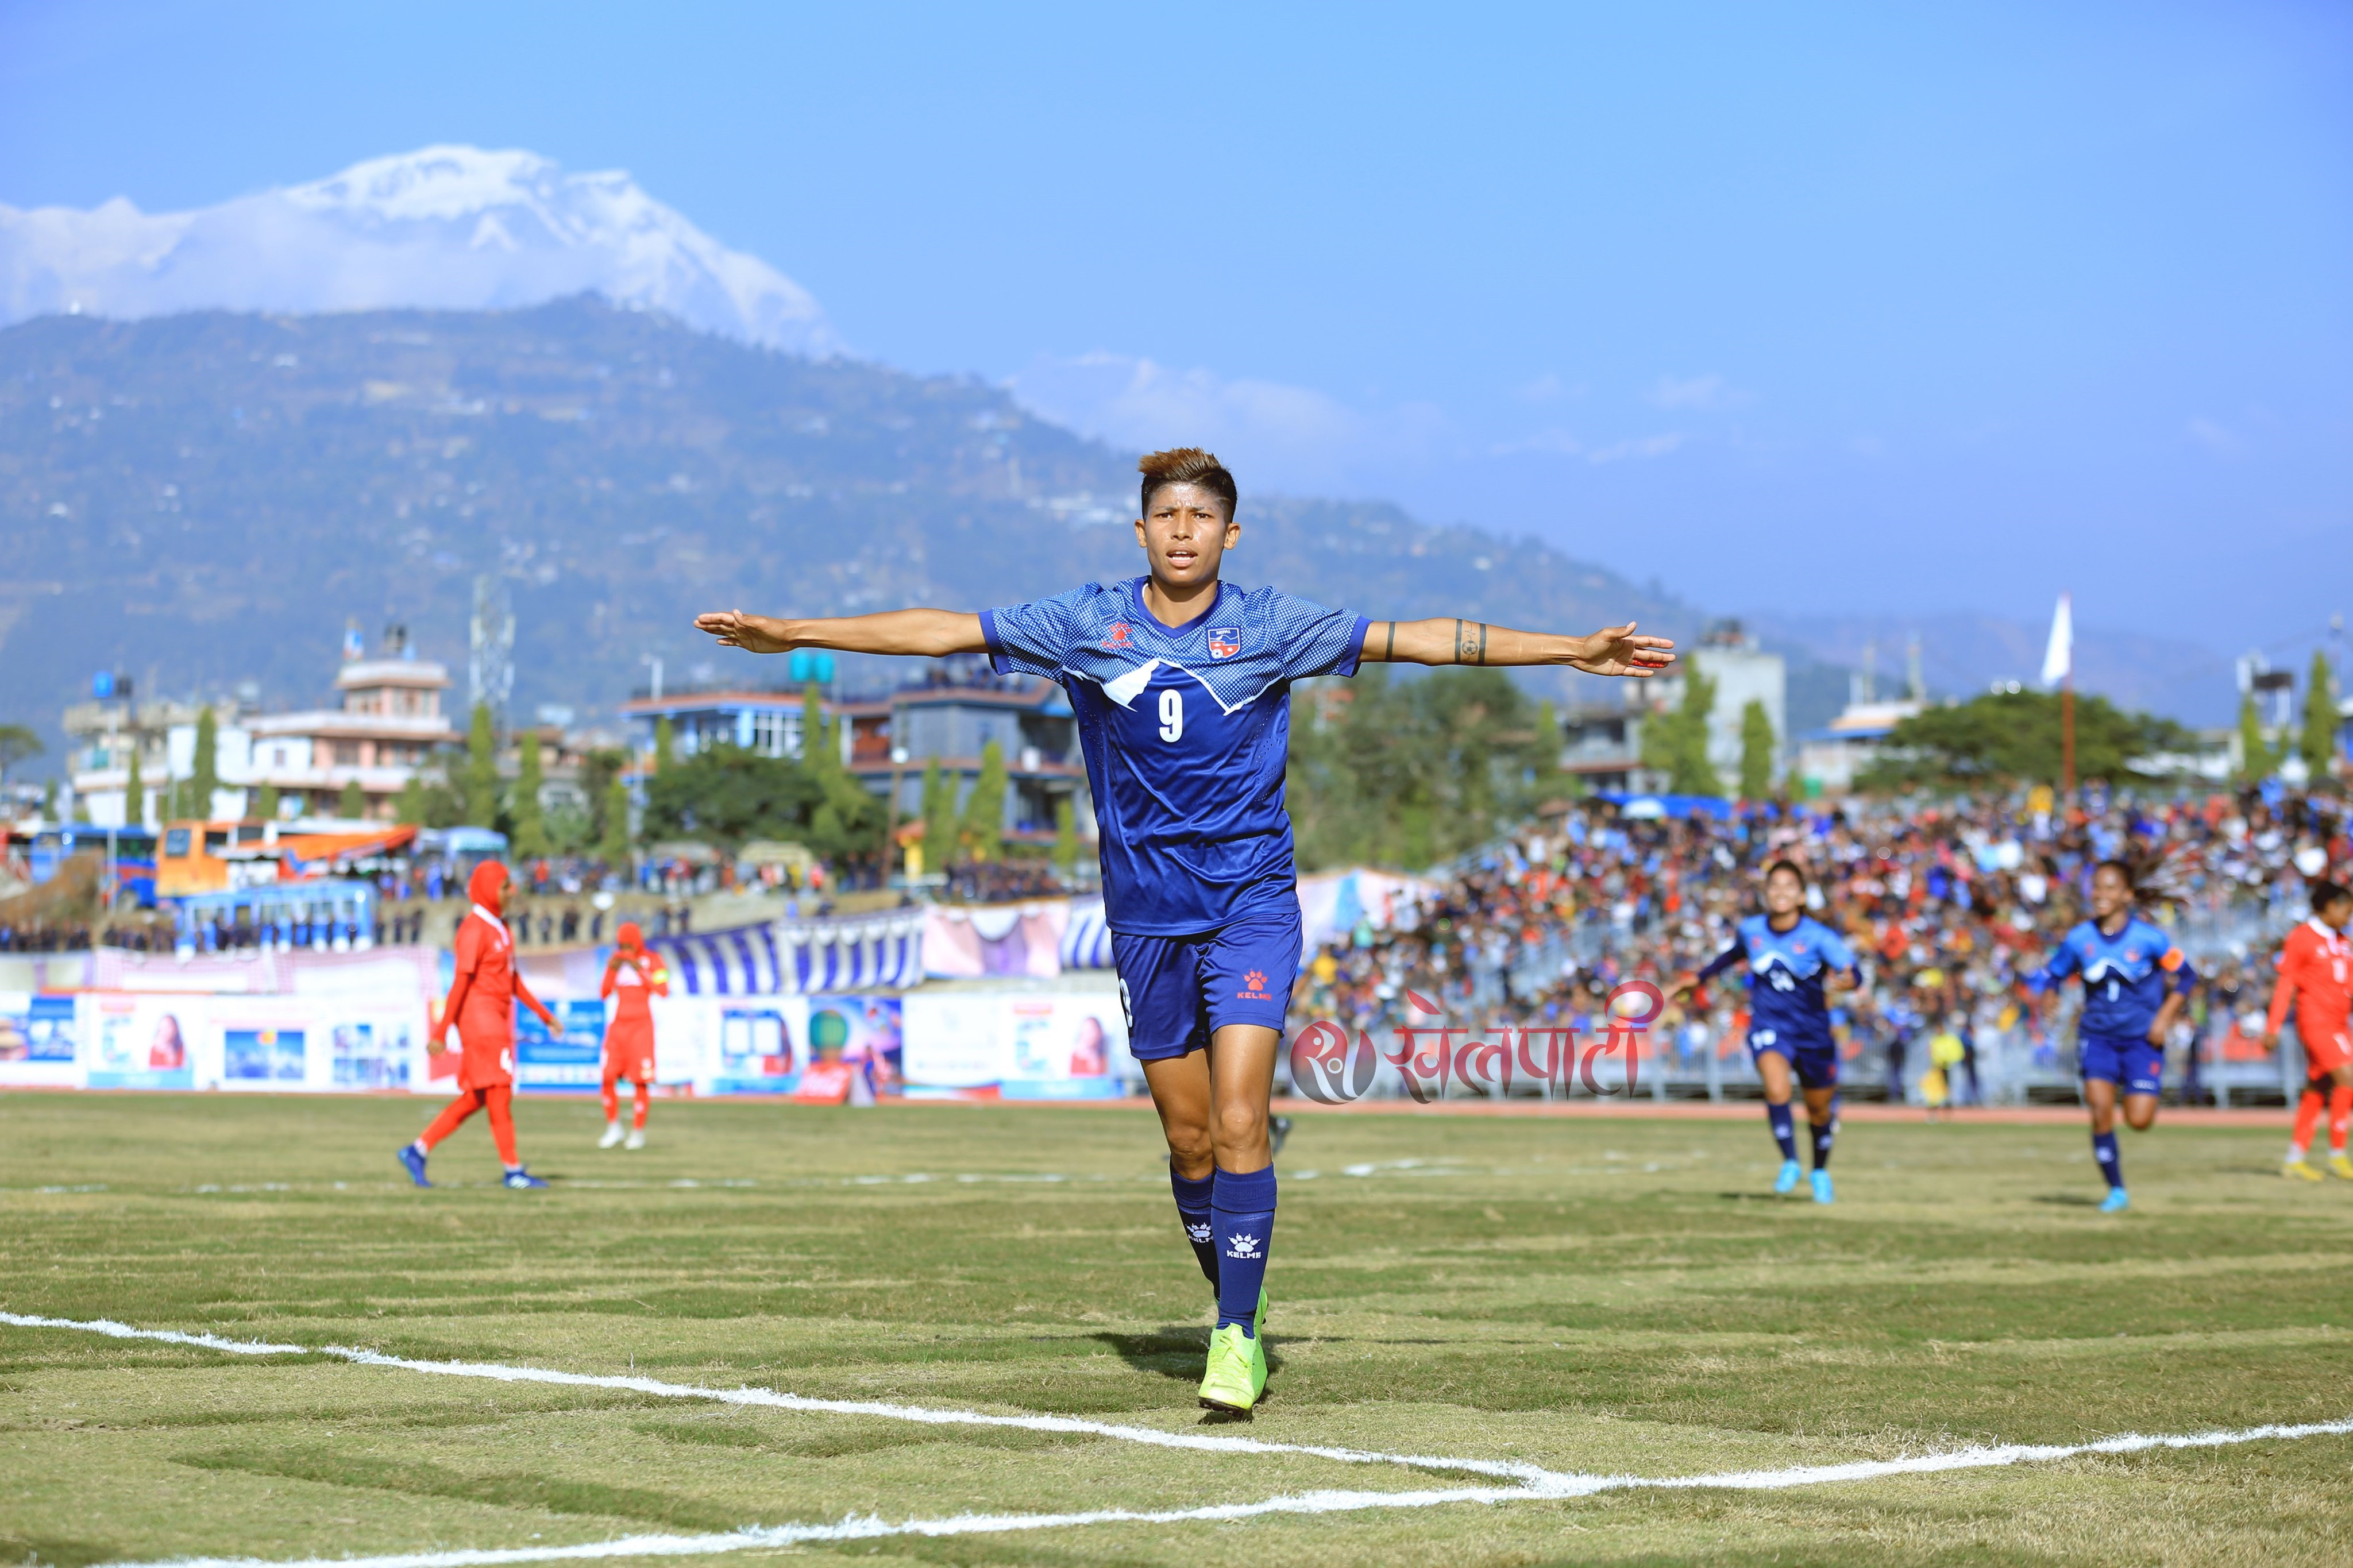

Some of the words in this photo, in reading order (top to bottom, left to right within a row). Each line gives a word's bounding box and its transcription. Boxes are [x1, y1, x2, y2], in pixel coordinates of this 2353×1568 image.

[1158, 689, 1183, 742] 9
[1237, 992, 1272, 1001] KELME
[1187, 1234, 1214, 1243] KELM
[1226, 1249, 1262, 1259] KELME
